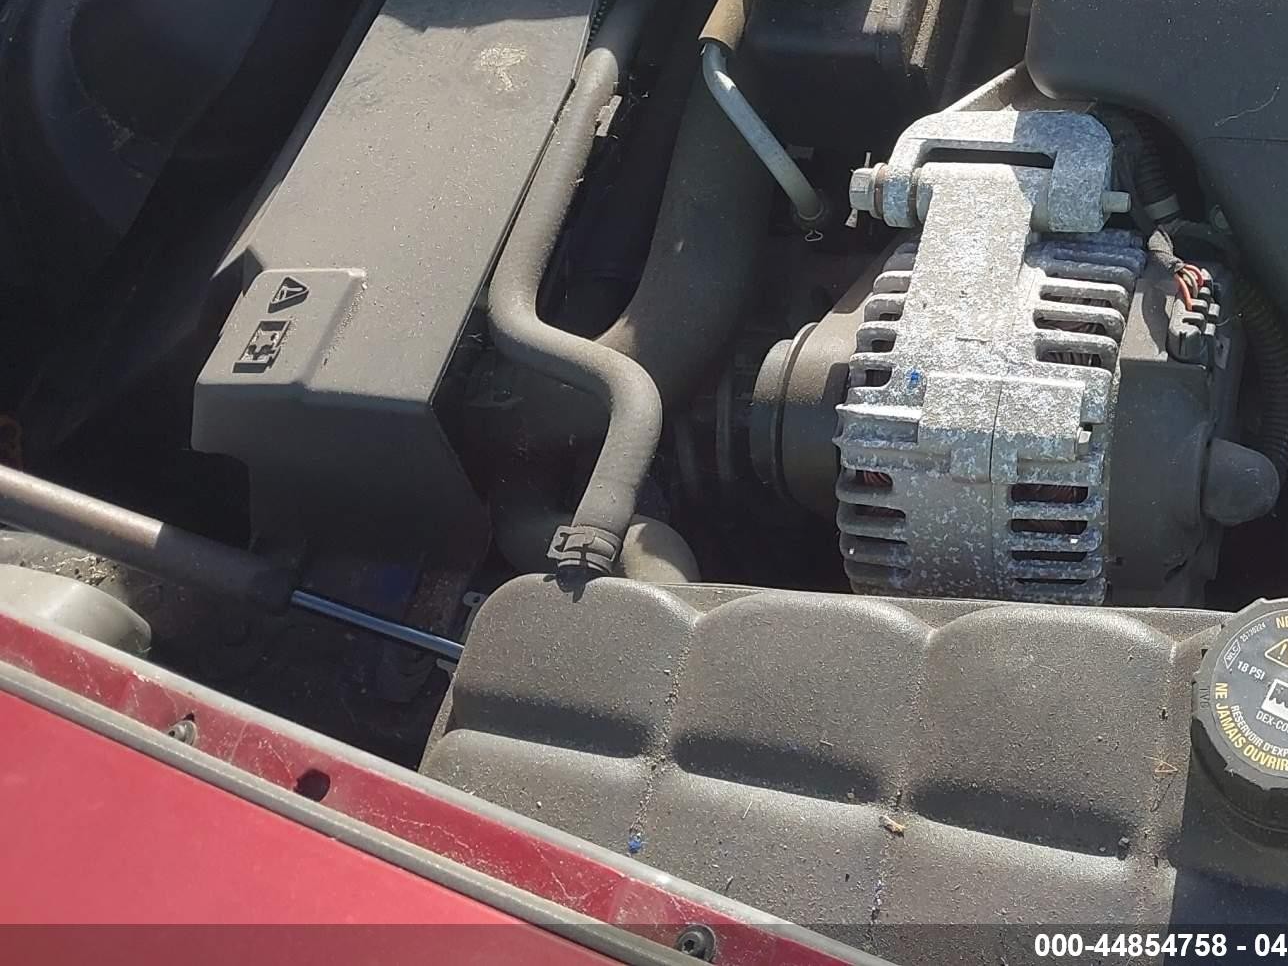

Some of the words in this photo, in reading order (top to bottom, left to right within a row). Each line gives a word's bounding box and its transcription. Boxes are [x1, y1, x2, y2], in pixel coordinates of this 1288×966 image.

[1237, 660, 1249, 673] 18
[1248, 664, 1266, 681] PSI
[1215, 682, 1228, 700] NE
[1216, 703, 1246, 748] JAMAIS
[1231, 705, 1264, 748] RESERVOIR
